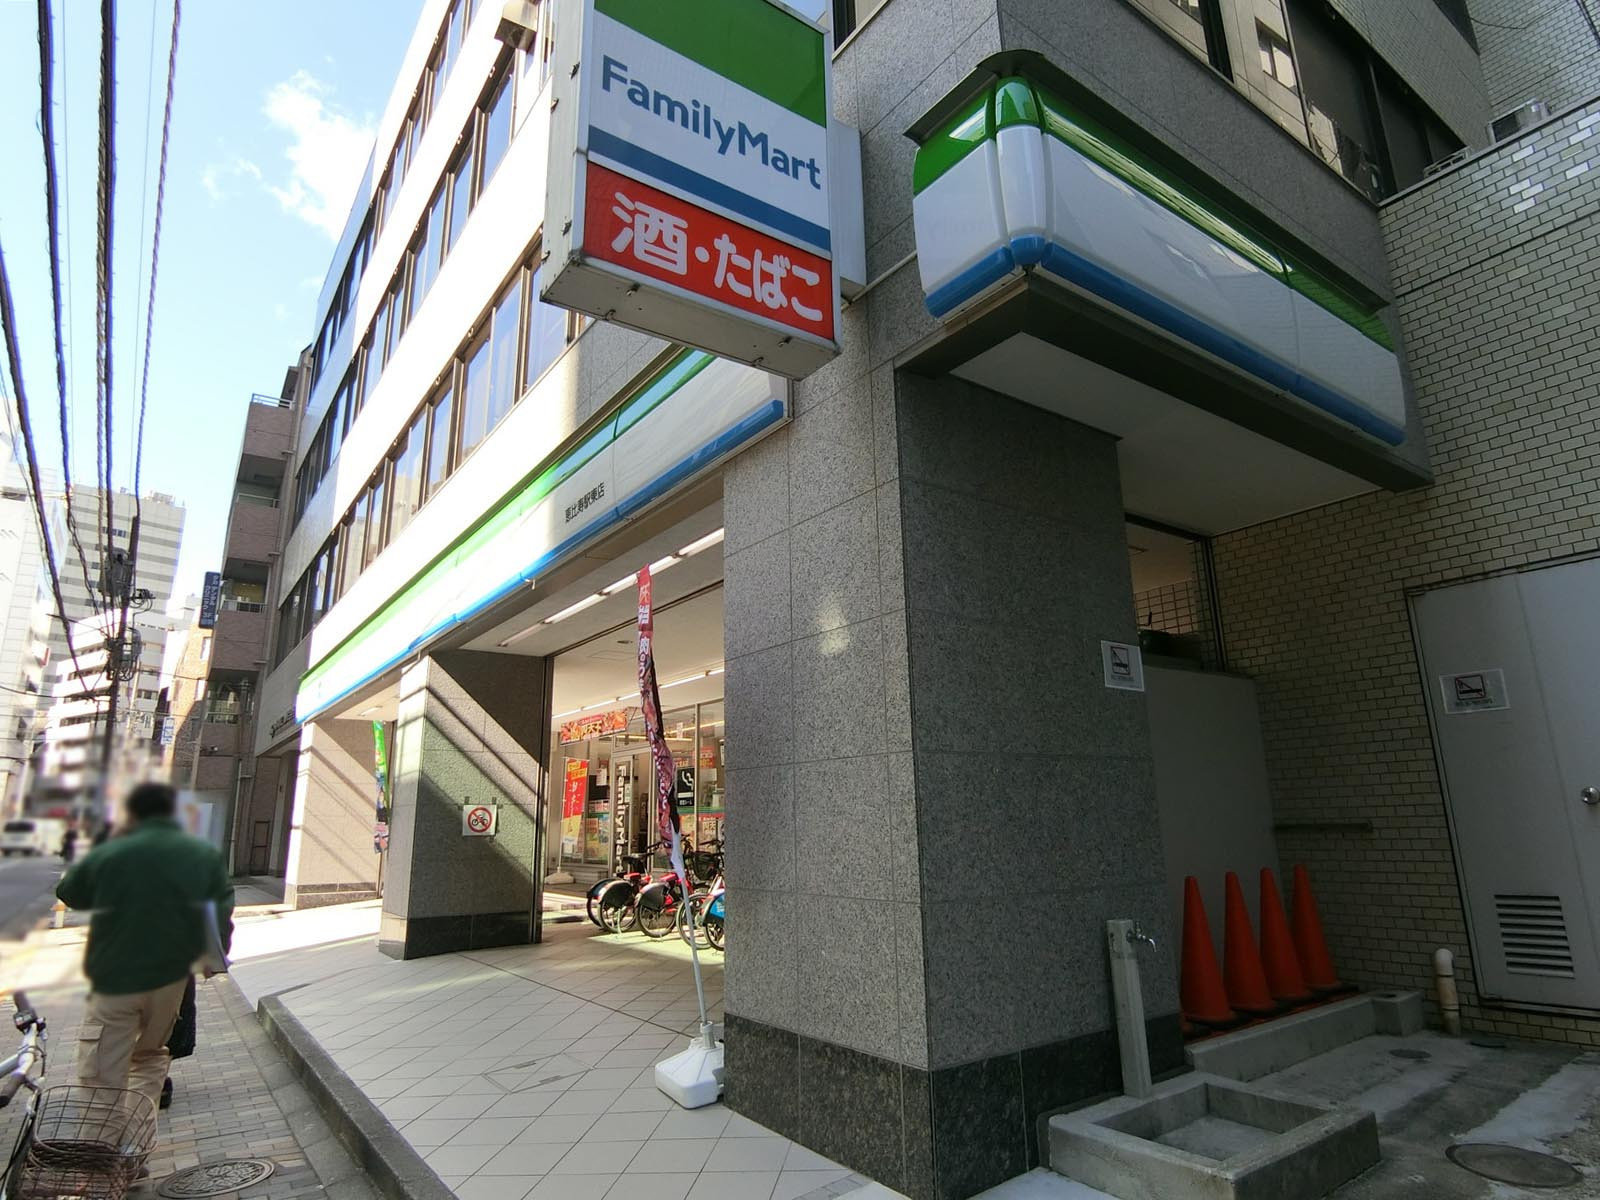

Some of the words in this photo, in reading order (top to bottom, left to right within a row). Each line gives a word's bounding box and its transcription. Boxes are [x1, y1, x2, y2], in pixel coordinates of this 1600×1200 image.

[601, 53, 821, 190] FamilyMart
[611, 191, 823, 322] 酒・たばこ
[564, 481, 606, 524] 恵比寿駅東店
[614, 764, 628, 873] FamilyMart
